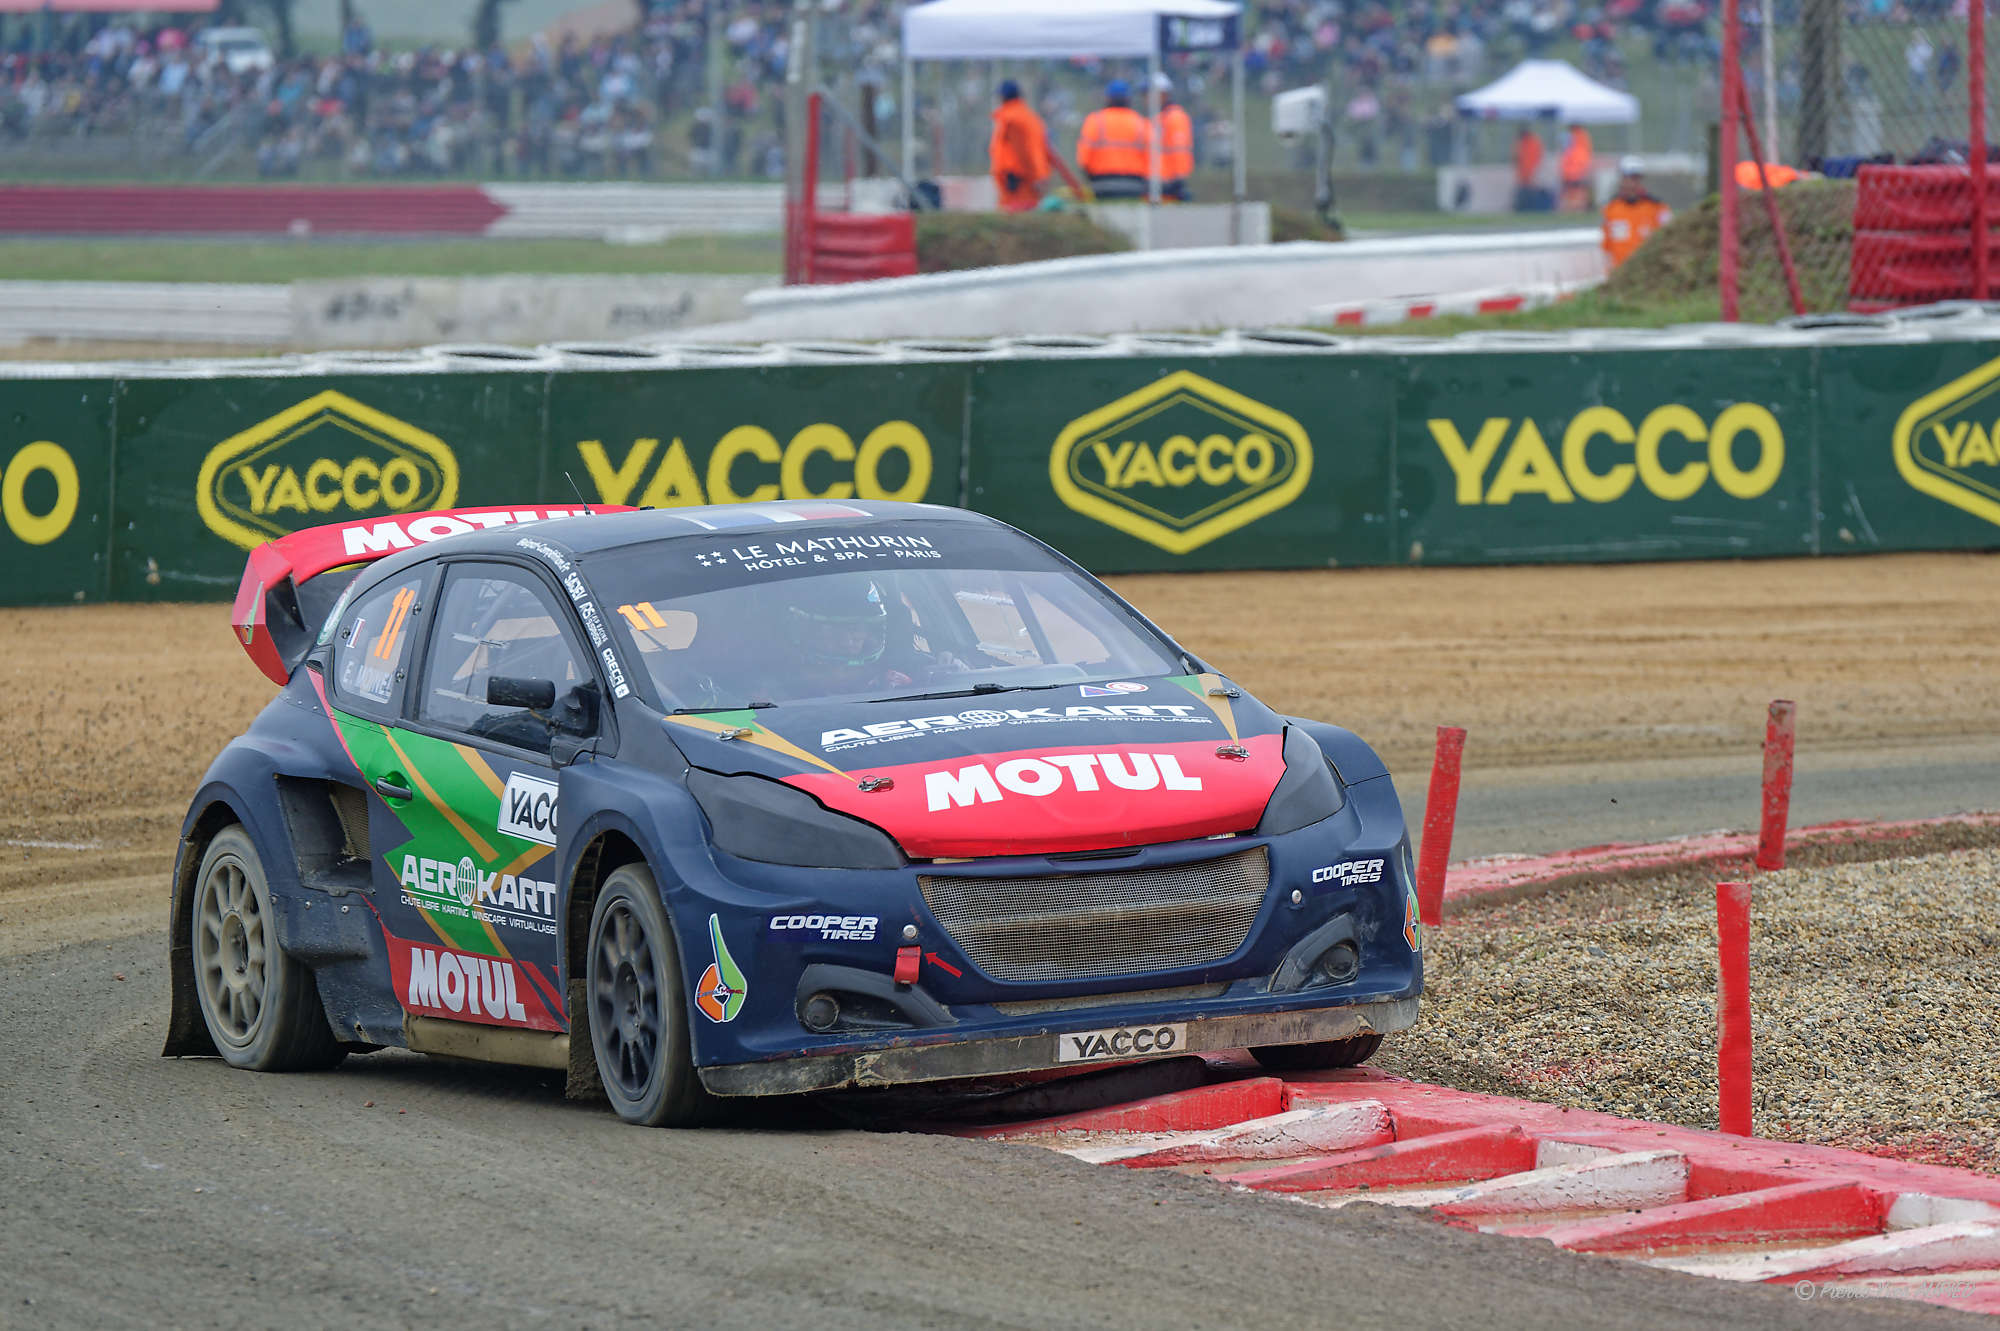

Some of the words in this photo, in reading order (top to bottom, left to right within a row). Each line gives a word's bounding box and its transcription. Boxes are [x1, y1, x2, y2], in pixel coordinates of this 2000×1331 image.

[1093, 434, 1275, 487] YACCO
[1428, 404, 1784, 503] YACCO
[1933, 418, 2000, 467] YA
[578, 422, 932, 505] YACCO
[0, 440, 80, 544] O
[239, 457, 422, 514] YACCO
[342, 510, 596, 556] MOT
[732, 545, 769, 562] LE
[775, 535, 934, 556] MATHURIN
[813, 554, 828, 563] &
[834, 551, 868, 561] SPA
[894, 548, 942, 559] PARIS
[374, 587, 416, 660] 11
[616, 601, 668, 632] 11
[825, 739, 878, 753] CHUTE
[879, 732, 925, 744] LIBRE
[925, 752, 1203, 812] MOTUL
[1313, 858, 1385, 883] COOPER
[1340, 872, 1382, 887] TIRES
[442, 904, 469, 918] KARTING
[472, 910, 507, 925] WINSCAPE
[769, 915, 879, 931] COOPER
[820, 929, 876, 941] TIRES
[409, 947, 527, 1022] MOTUL
[1072, 1027, 1176, 1058] YACCO
